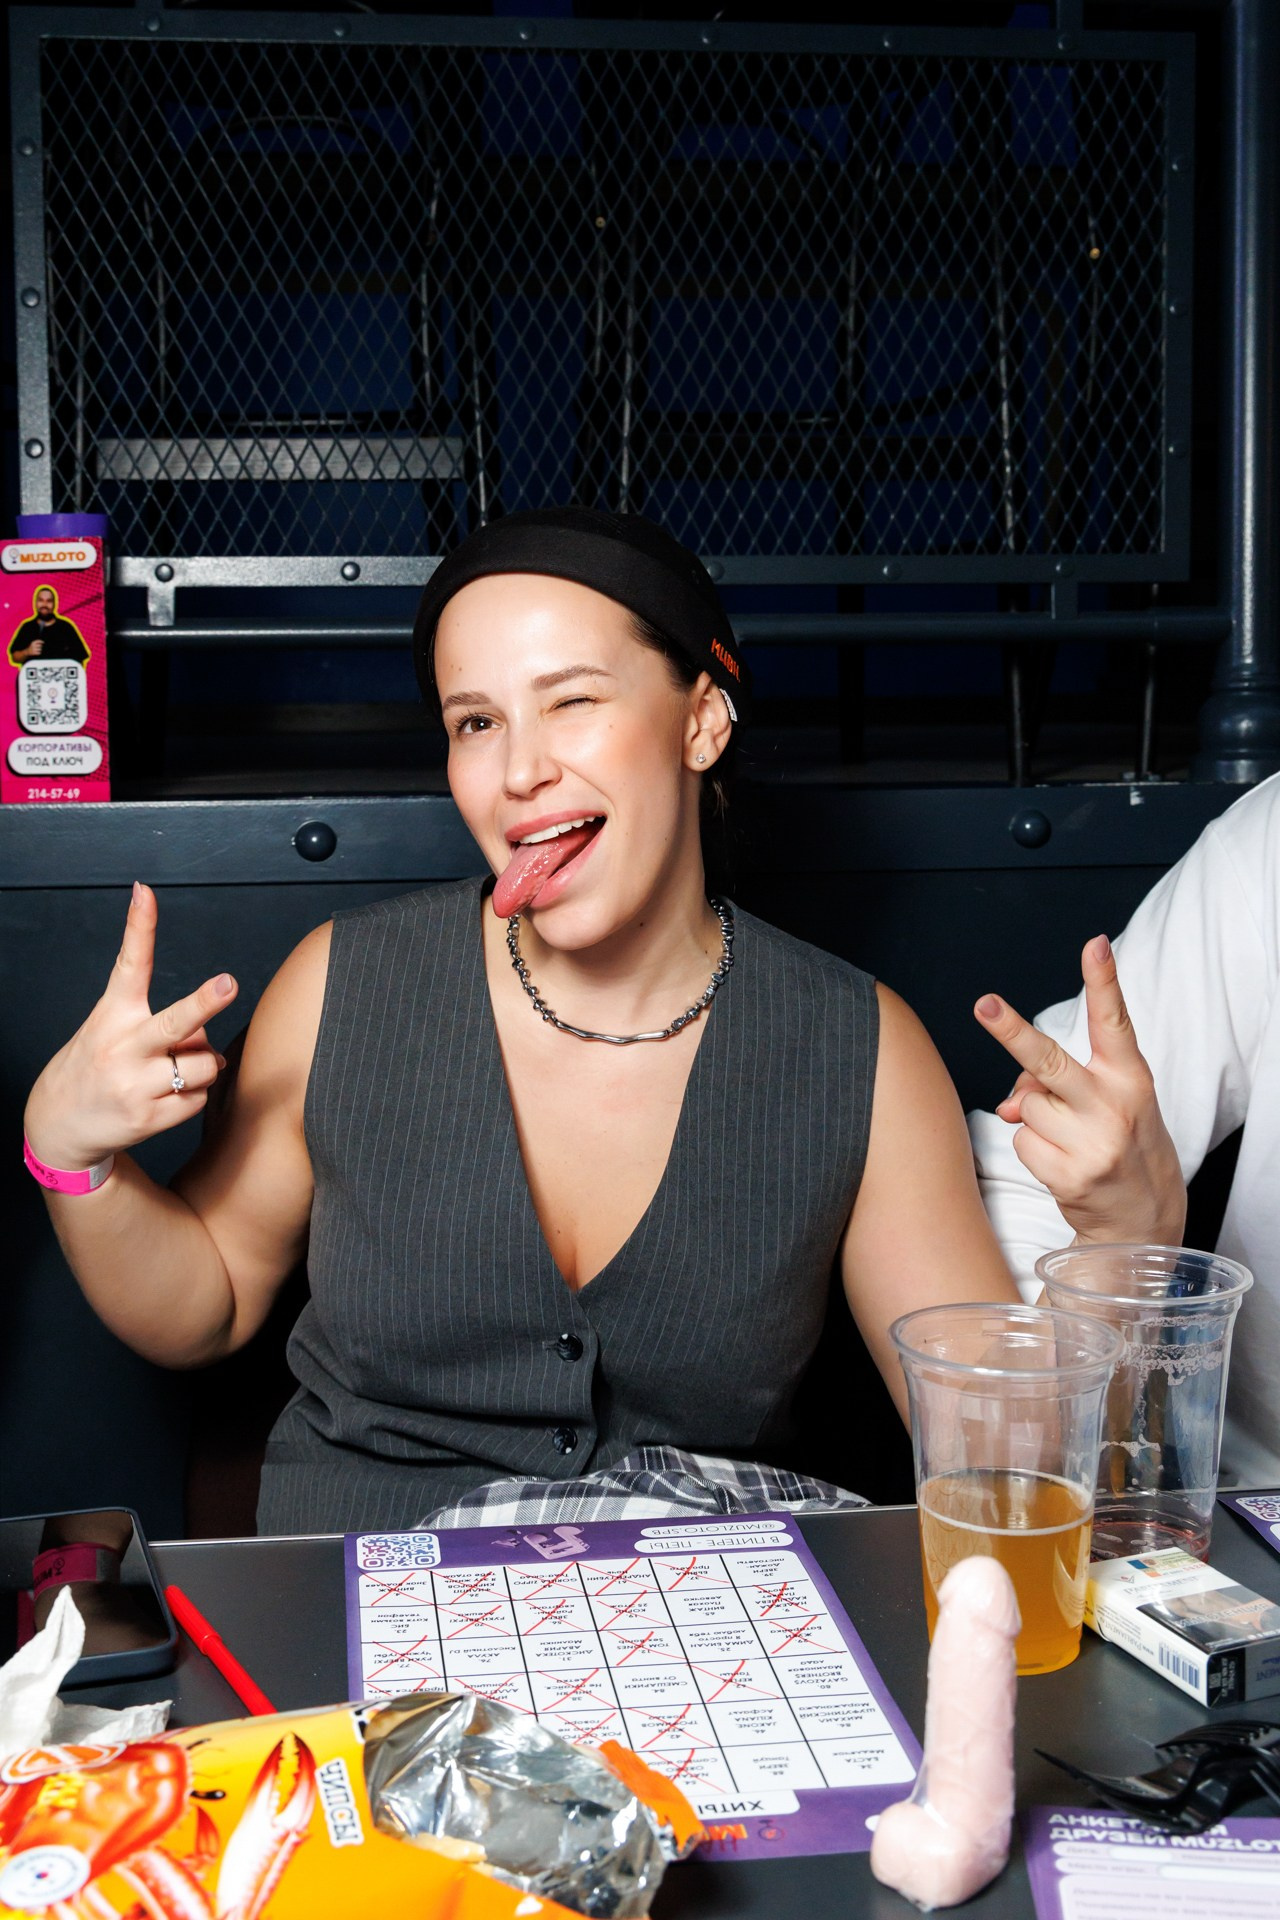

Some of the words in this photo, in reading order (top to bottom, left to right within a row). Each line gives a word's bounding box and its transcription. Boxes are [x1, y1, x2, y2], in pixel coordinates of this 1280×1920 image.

[20, 551, 87, 564] MUZLOTO
[17, 743, 93, 754] КОРПОРАТИВЫ
[26, 757, 50, 768] ПОД
[52, 756, 84, 767] КЛЮЧ
[27, 788, 81, 800] 214-57-69
[707, 1536, 765, 1546] ПИТЕРЕ
[769, 1535, 779, 1543] В
[649, 1540, 692, 1549] ПЕТЬ!
[756, 1600, 807, 1609] НАДЕЖДА
[535, 1649, 593, 1657] ДИСКОТЕКА
[787, 1664, 842, 1672] Малиновая
[624, 1681, 688, 1689] СМЕШАРИКИ
[798, 1707, 875, 1718] ШУФУТИНСКИЙ
[818, 1715, 862, 1723] МИХАИЛ
[320, 1761, 358, 1841] ЧИПСЫ
[697, 1800, 763, 1814] ХИТЫ
